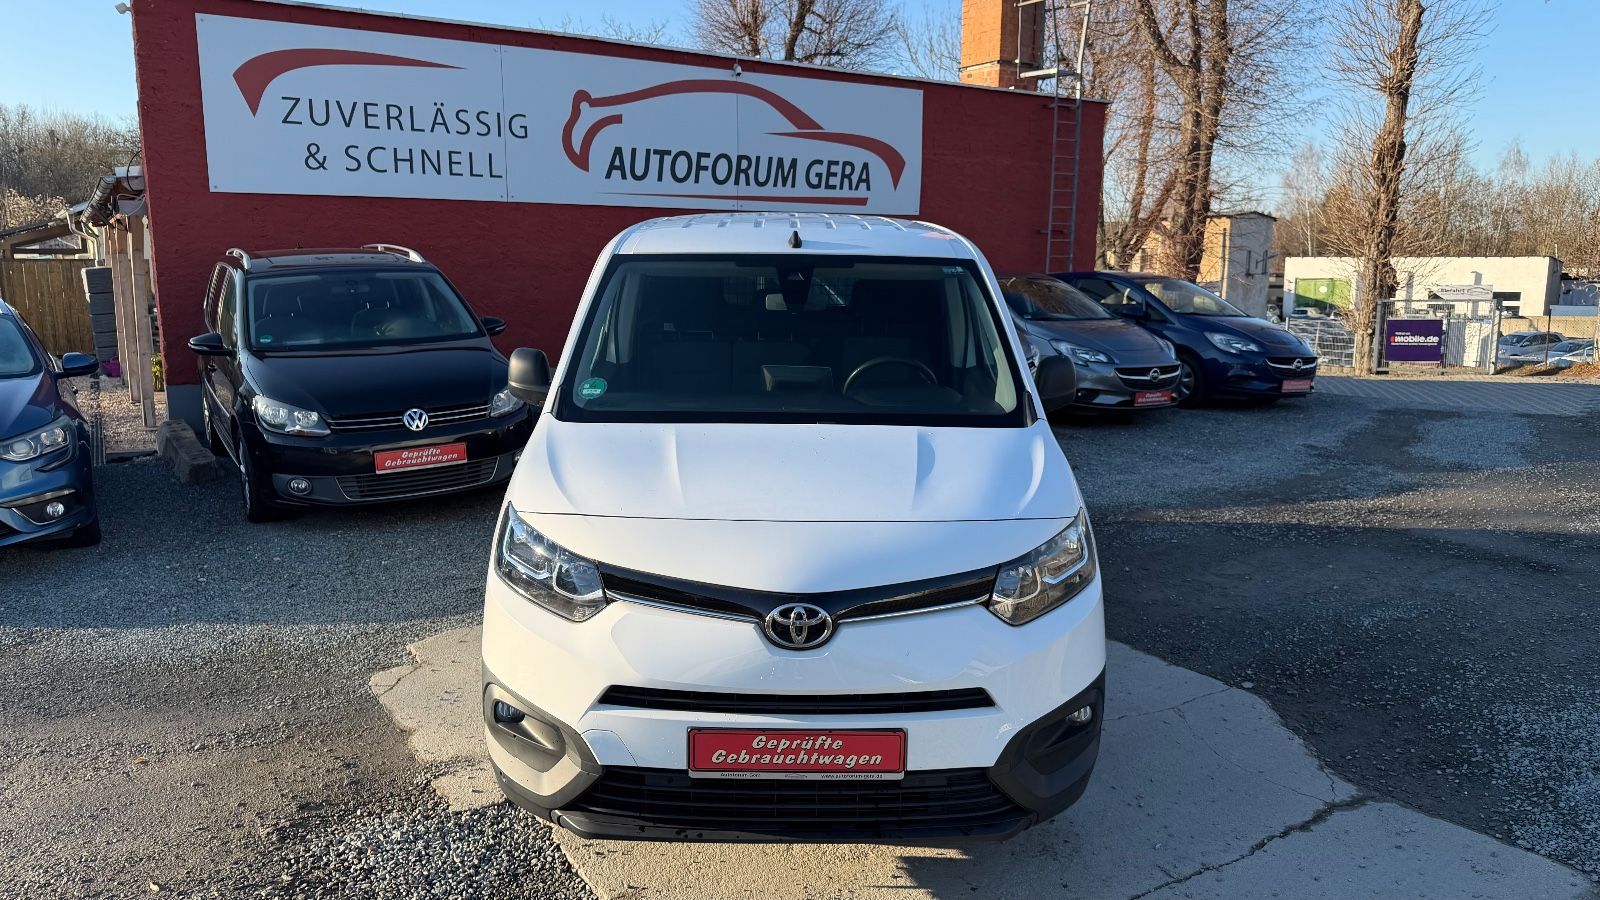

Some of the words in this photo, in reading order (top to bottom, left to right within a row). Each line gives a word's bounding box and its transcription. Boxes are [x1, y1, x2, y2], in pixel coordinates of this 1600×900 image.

[281, 96, 528, 139] ZUVERLÄSSIG
[304, 142, 328, 171] &
[344, 144, 503, 179] SCHNELL
[604, 146, 798, 189] AUTOFORUM
[804, 159, 871, 191] GERA
[384, 453, 458, 467] Gebrauchtwagen
[401, 447, 441, 459] Geprüfte
[751, 735, 843, 753] Geprüfte
[711, 750, 882, 768] Gebrauchtwagen
